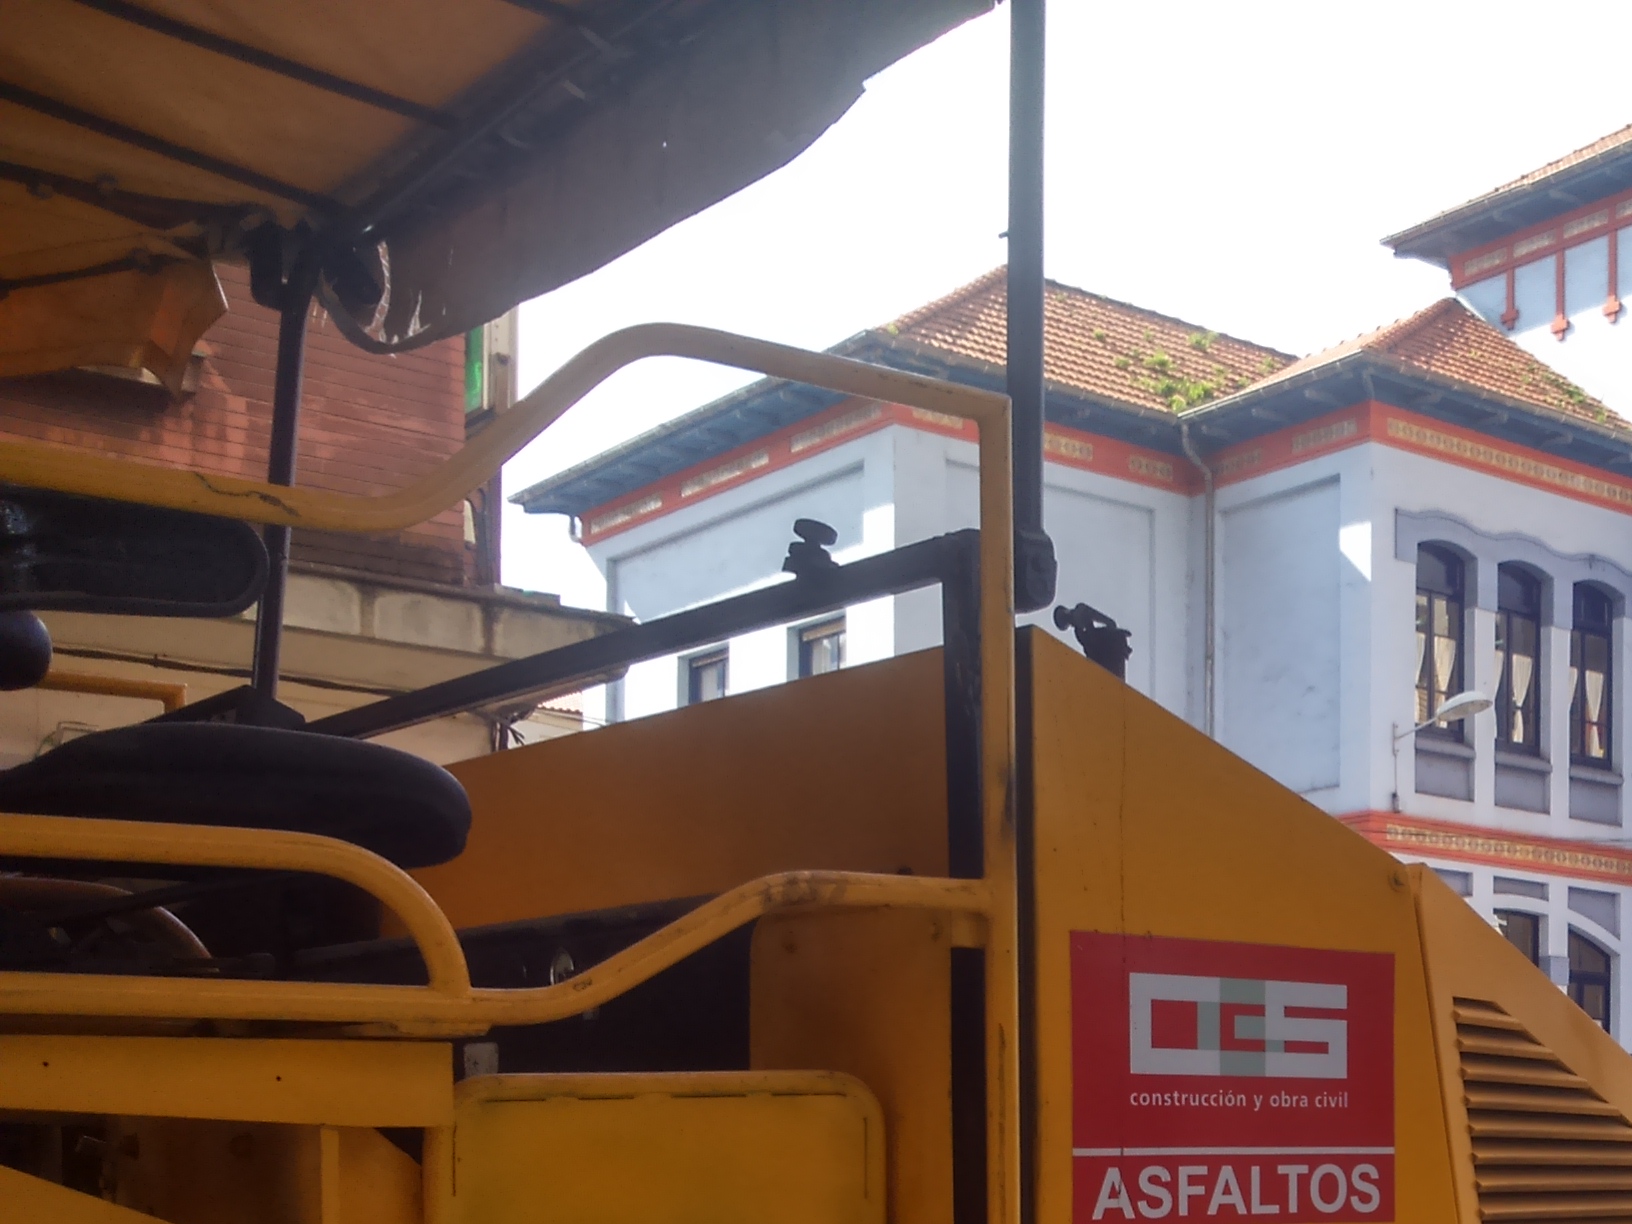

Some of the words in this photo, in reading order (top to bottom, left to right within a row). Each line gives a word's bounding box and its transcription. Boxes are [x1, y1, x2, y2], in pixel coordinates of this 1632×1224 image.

[1130, 1089, 1246, 1107] construcción
[1253, 1093, 1263, 1111] y
[1270, 1090, 1309, 1108] obra
[1315, 1091, 1349, 1108] civil
[1091, 1162, 1381, 1220] ASFALTOS
